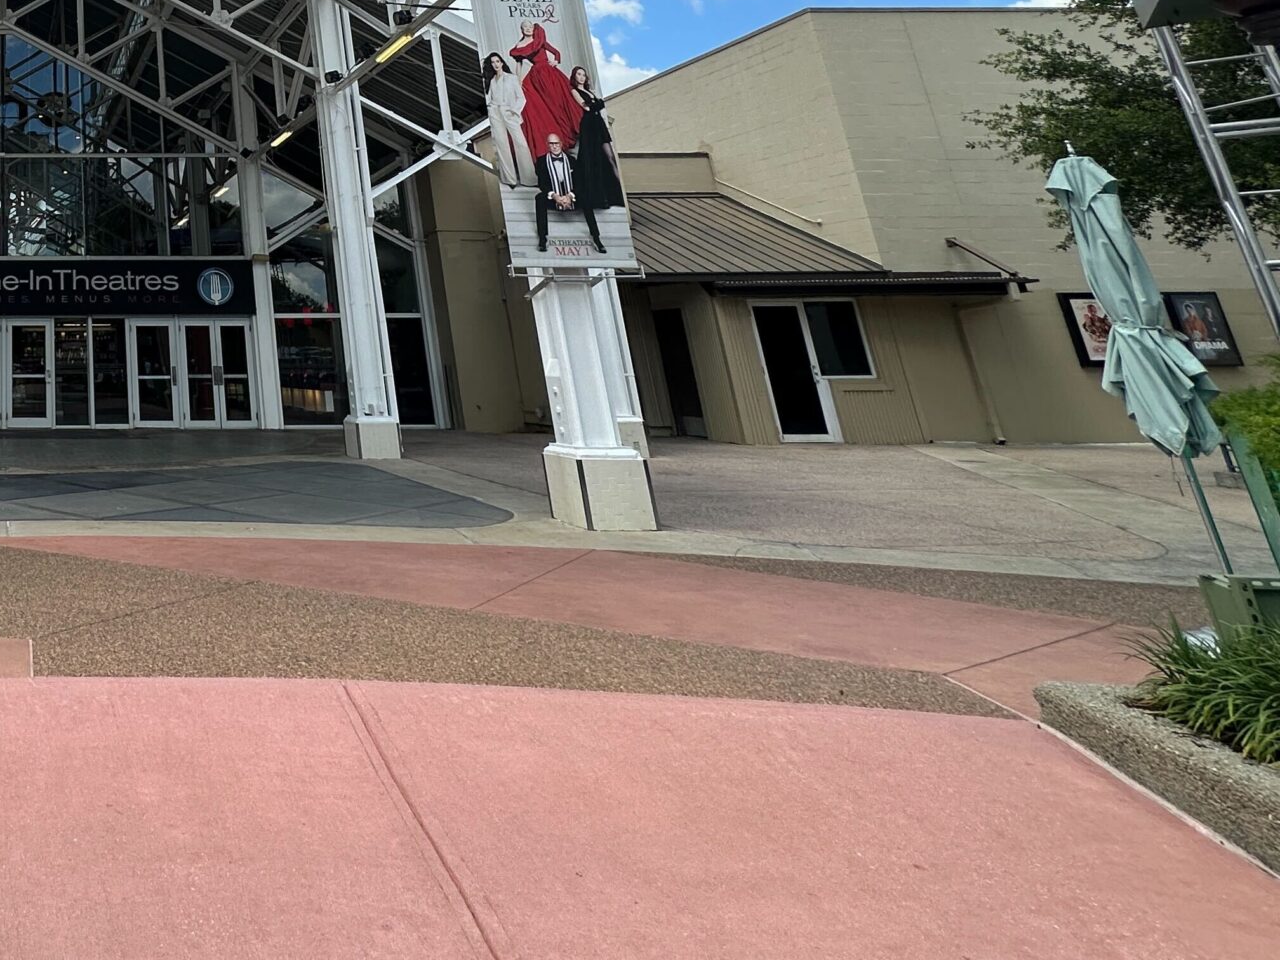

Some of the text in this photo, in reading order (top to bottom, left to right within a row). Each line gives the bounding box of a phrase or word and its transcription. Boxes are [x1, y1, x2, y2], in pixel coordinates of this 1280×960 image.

[559, 239, 592, 247] THEATERS
[554, 246, 590, 256] MAY 1
[46, 295, 111, 304] MENUS
